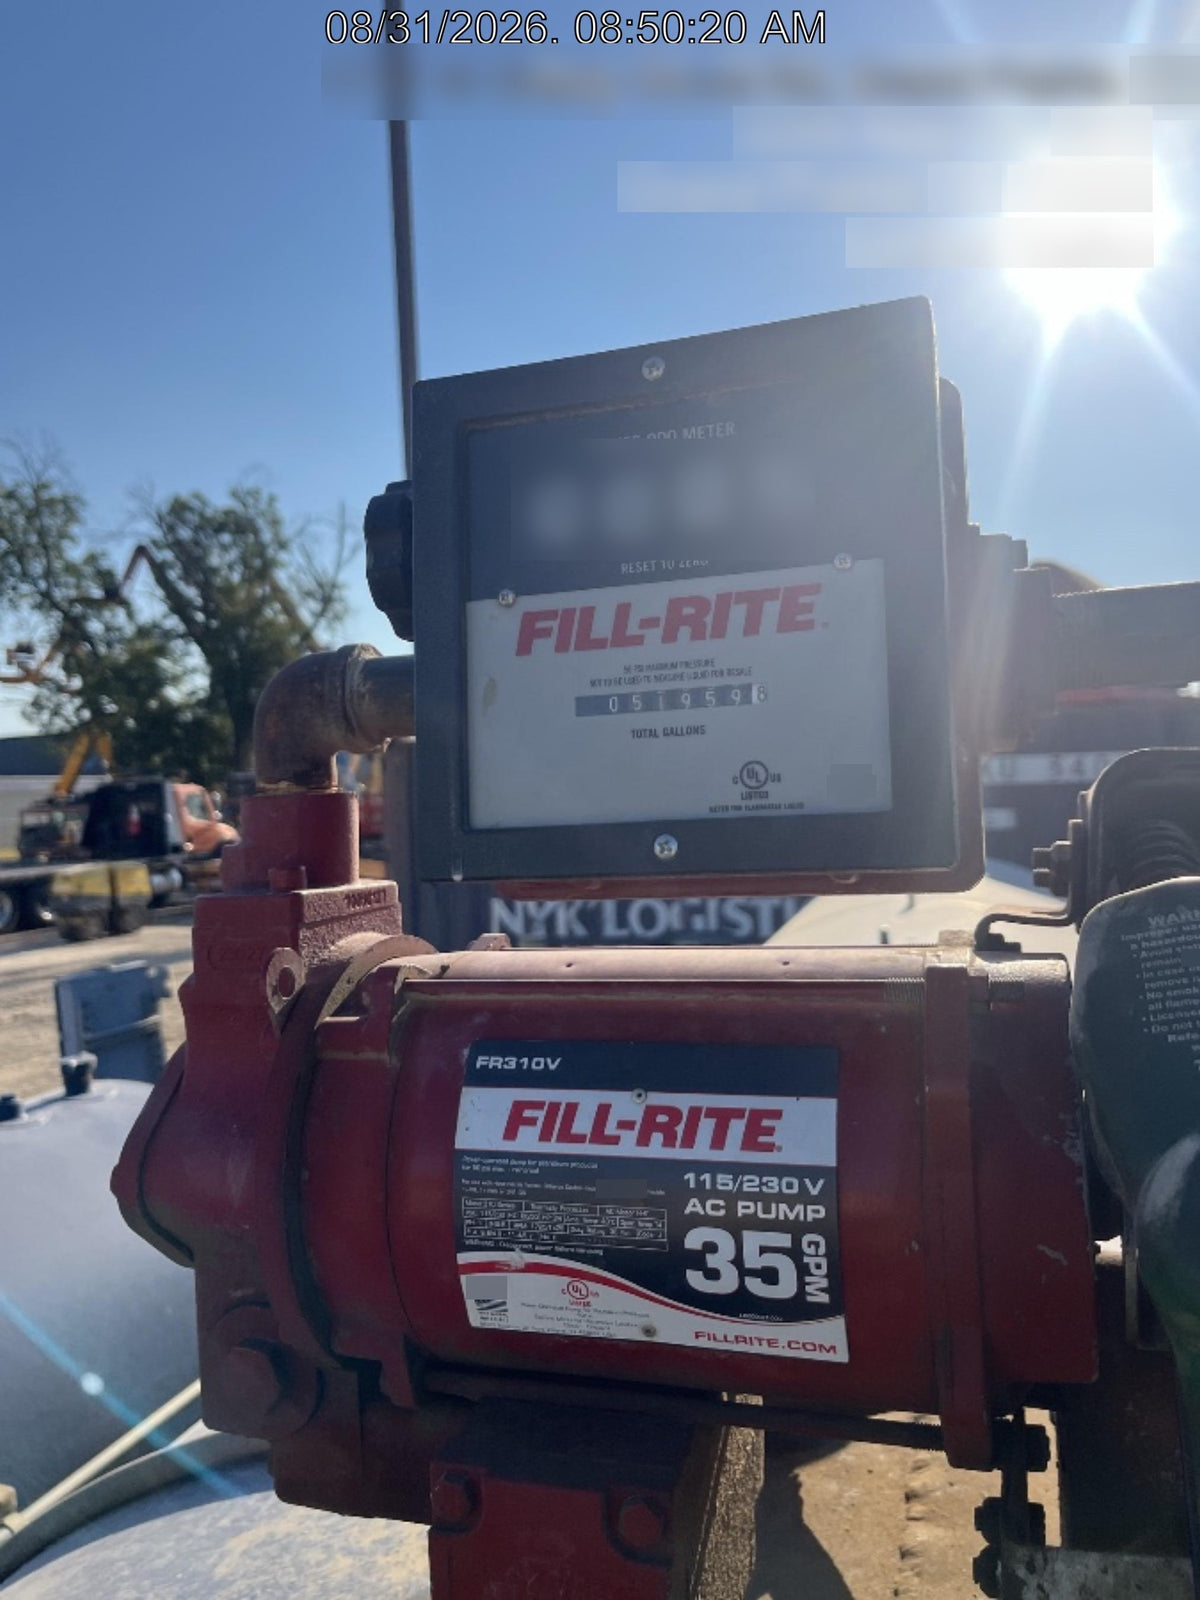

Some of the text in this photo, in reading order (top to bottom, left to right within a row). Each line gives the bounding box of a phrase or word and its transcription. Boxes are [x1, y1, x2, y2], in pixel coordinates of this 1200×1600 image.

[682, 421, 736, 440] METER
[620, 560, 656, 575] RESET
[515, 582, 822, 657] FILL-RITE
[631, 724, 706, 739] TOTAL GALLONS
[746, 766, 762, 784] UL
[490, 897, 590, 937] NYK
[1144, 977, 1190, 990] remove
[476, 1055, 562, 1071] FR310V
[502, 1099, 782, 1152] FILL-RITE
[683, 1172, 825, 1196] 115/230 V
[684, 1198, 826, 1222] AC PUMP
[683, 1226, 799, 1299] 35
[801, 1232, 831, 1304] GPM
[694, 1330, 838, 1356] FILLRITE.COM
